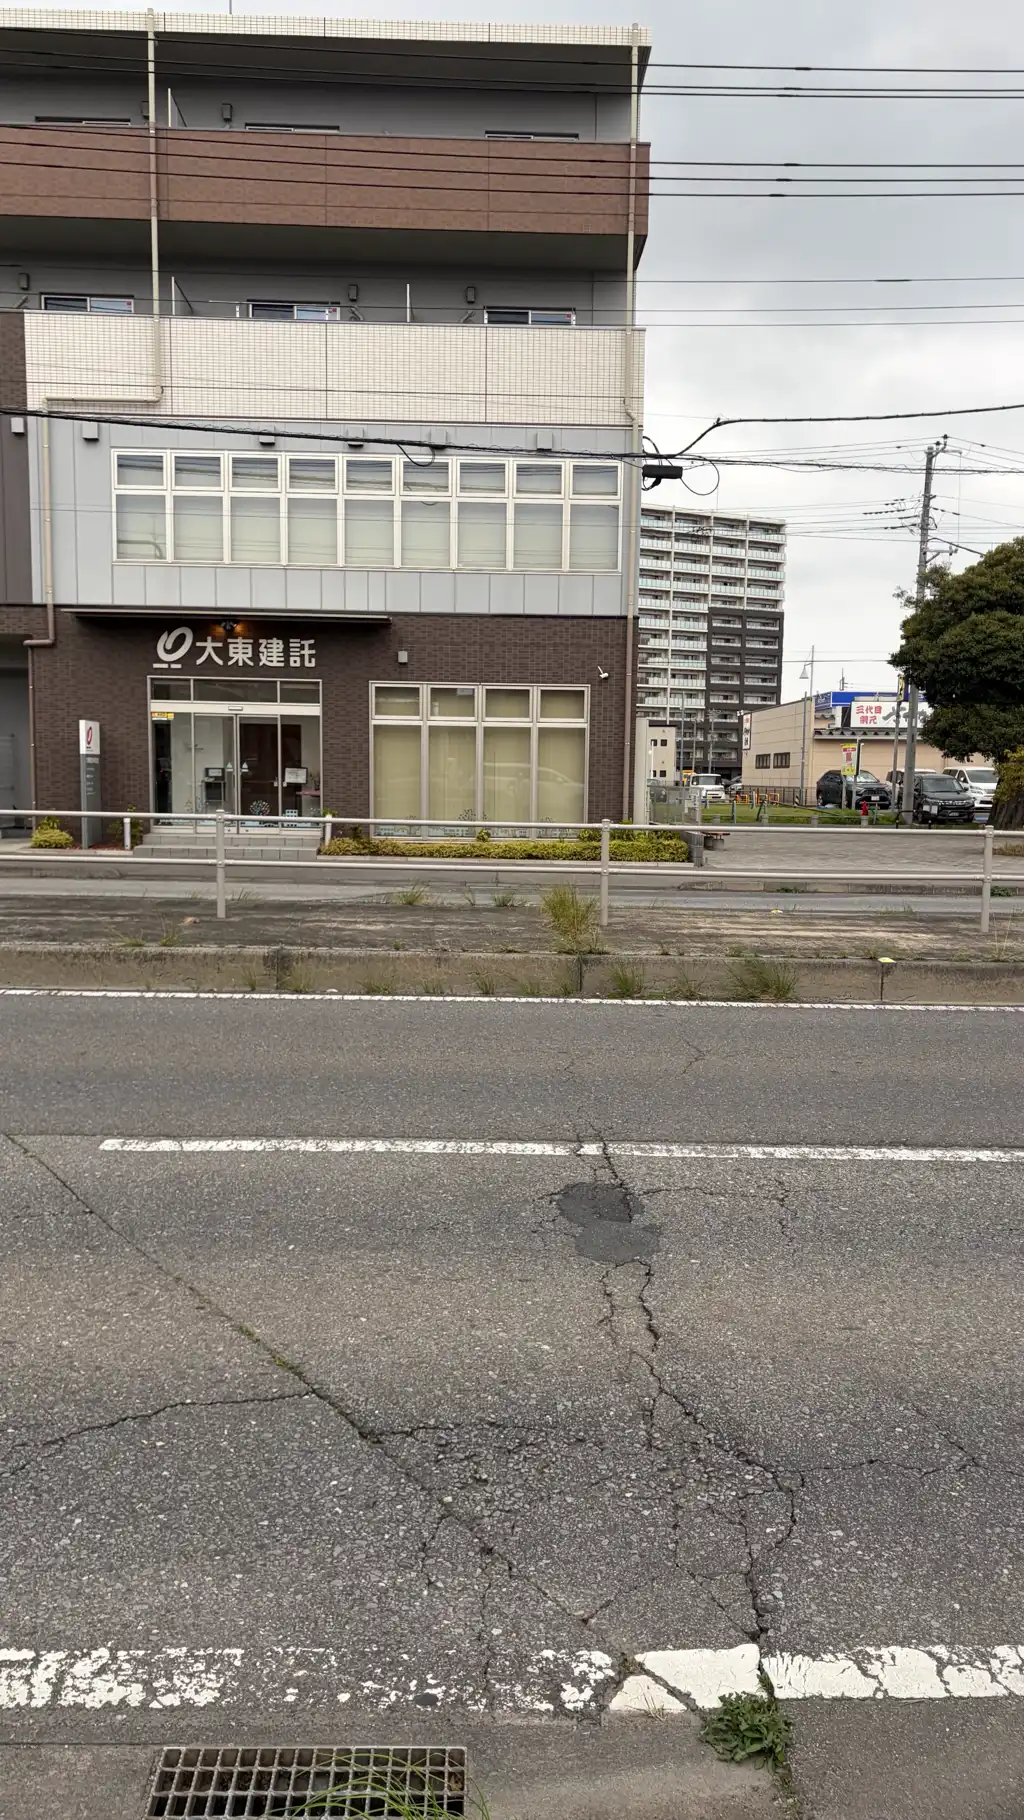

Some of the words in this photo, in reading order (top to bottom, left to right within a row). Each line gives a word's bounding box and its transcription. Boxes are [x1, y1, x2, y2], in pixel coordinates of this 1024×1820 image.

[195, 636, 316, 668] 大東建託
[855, 705, 883, 715] 三代目
